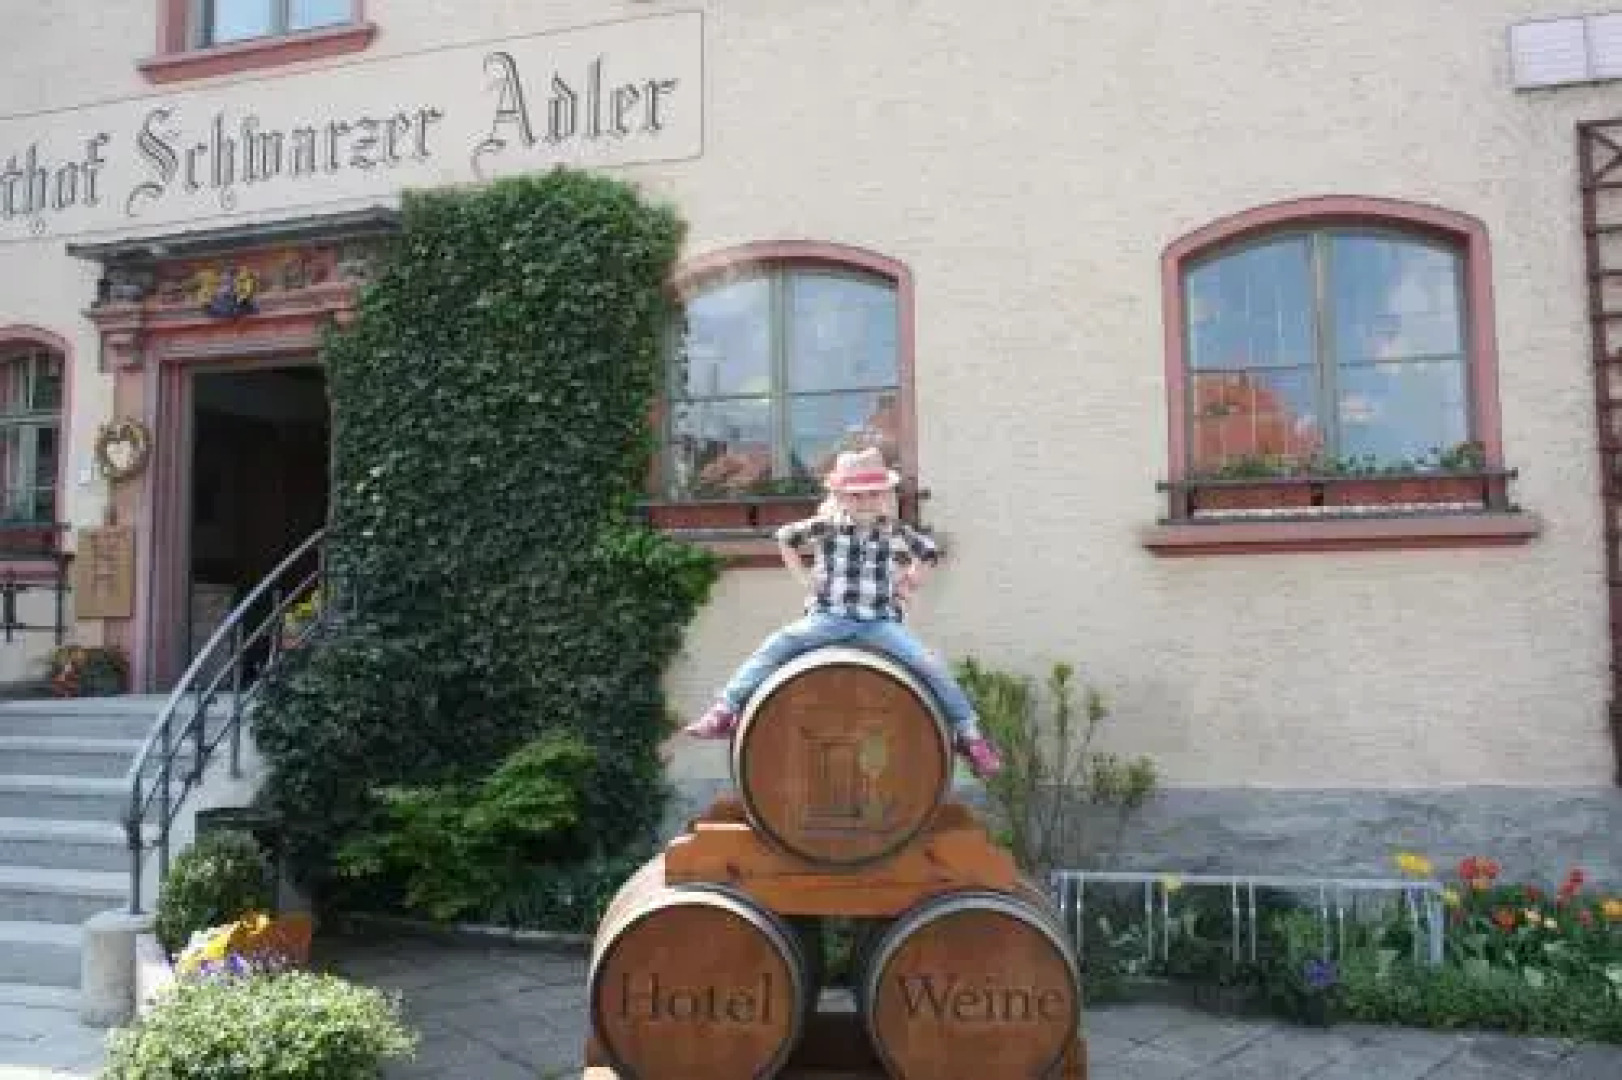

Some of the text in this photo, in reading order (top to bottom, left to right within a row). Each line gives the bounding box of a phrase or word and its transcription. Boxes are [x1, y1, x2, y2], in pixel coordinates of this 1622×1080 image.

[127, 104, 444, 217] Schwarzer
[470, 51, 679, 179] Adler
[619, 972, 1066, 1026] Hotel Weine
